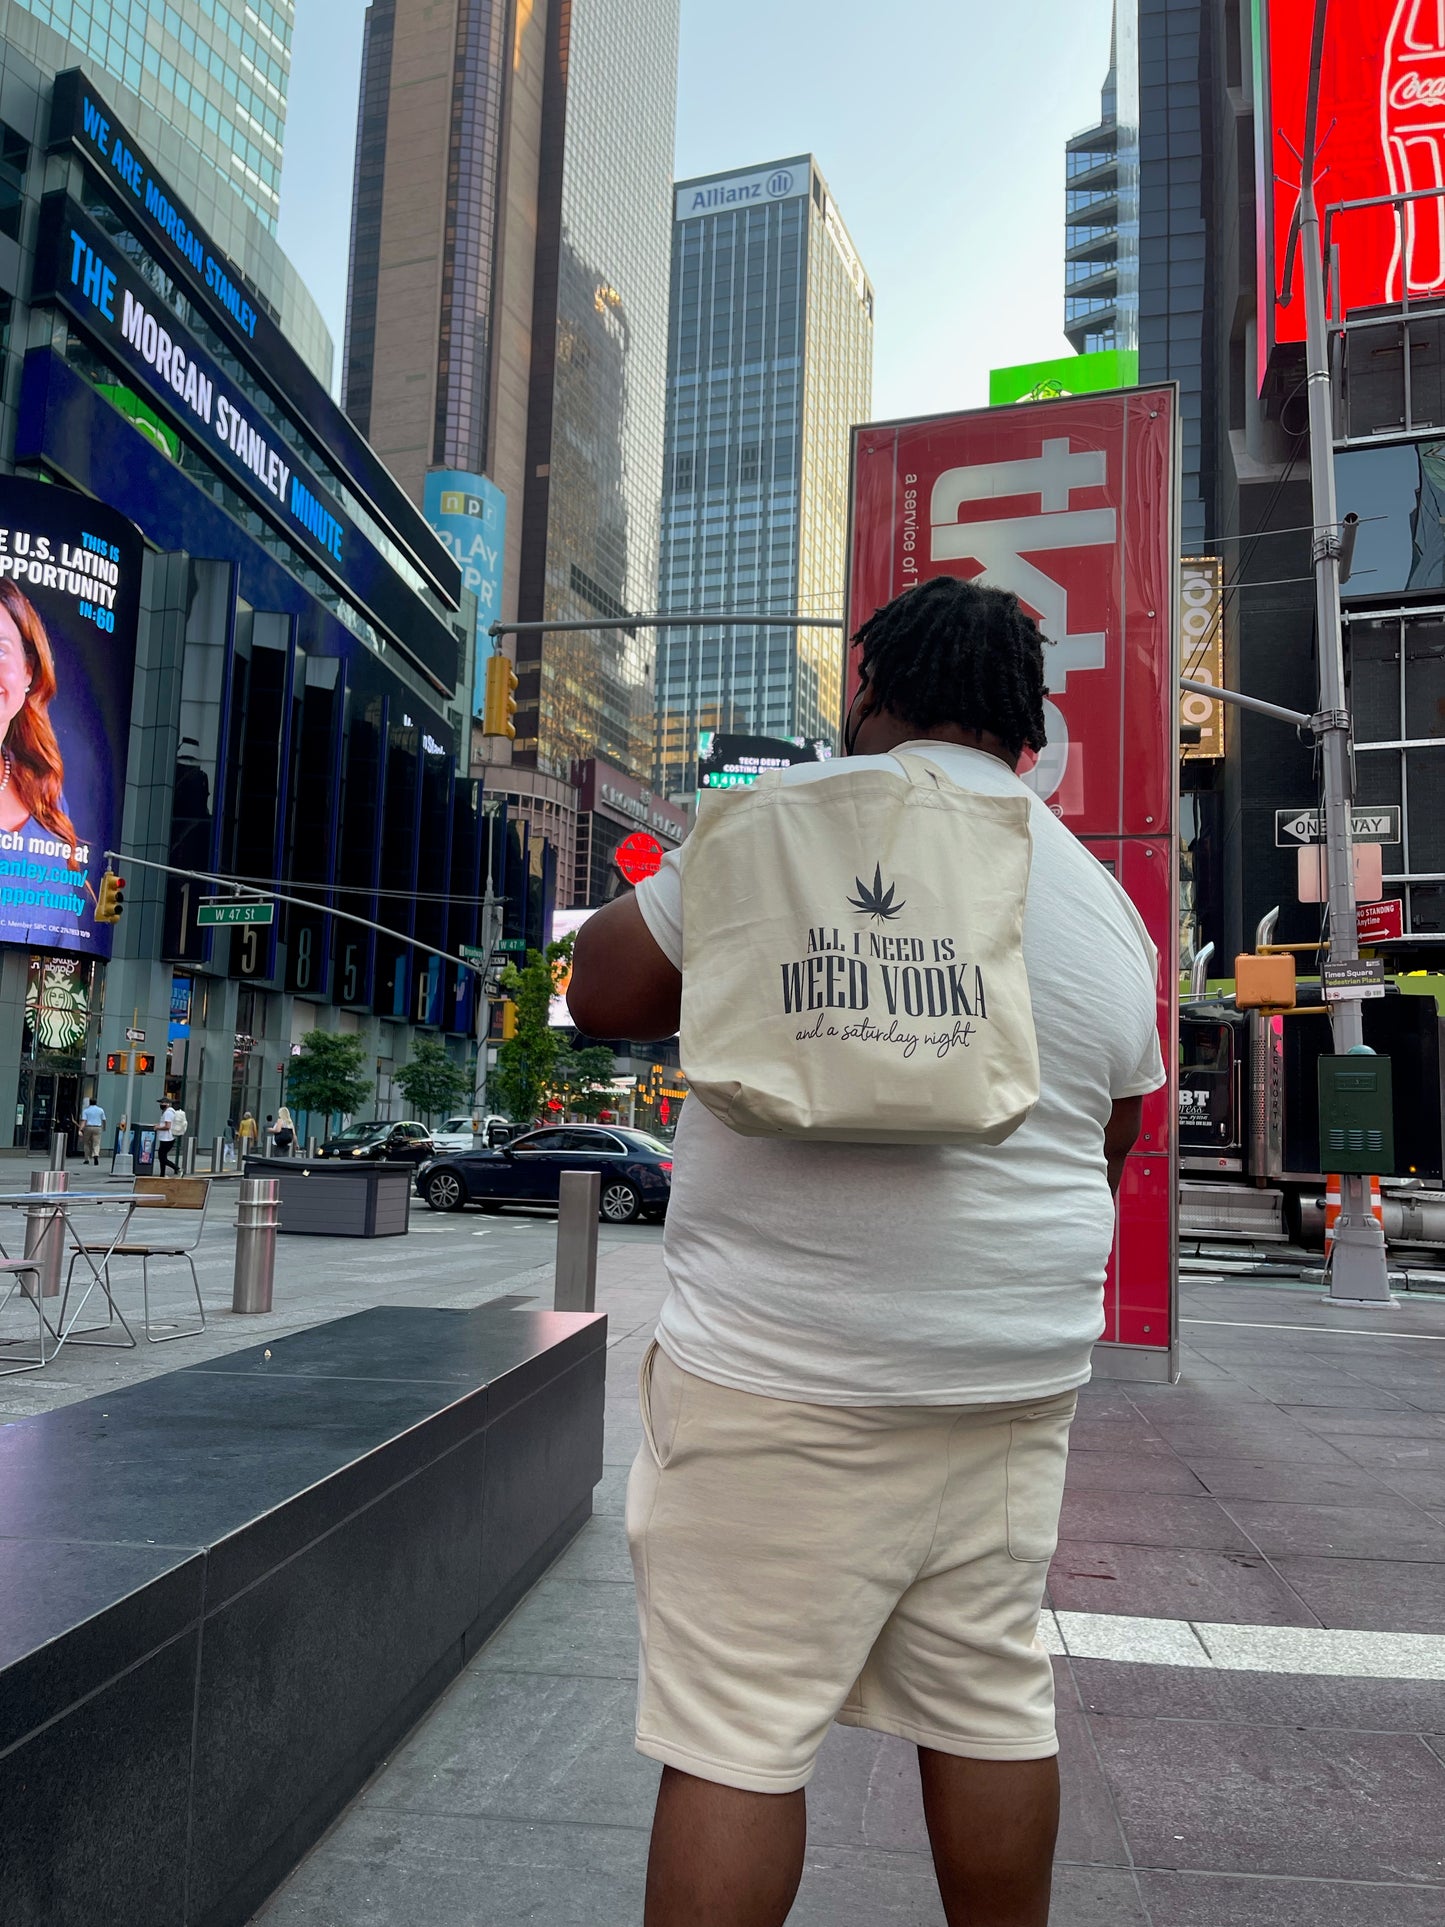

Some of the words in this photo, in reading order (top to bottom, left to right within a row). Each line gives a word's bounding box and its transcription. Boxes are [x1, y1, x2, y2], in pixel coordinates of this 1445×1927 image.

[1390, 71, 1445, 110] Coca
[691, 182, 761, 211] Allianz
[84, 97, 110, 156] WE
[111, 139, 143, 198] ARE
[145, 178, 203, 273] MORGAN
[205, 256, 257, 339] STANLEY
[70, 230, 117, 323] THE
[121, 289, 213, 424] MORGAN
[215, 395, 290, 502] STANLEY
[291, 476, 344, 562] MINUTE
[905, 473, 918, 485] a
[446, 496, 493, 518] npr
[903, 489, 919, 552] service
[14, 532, 55, 562] U.S.
[61, 543, 119, 586] LATINO
[82, 531, 107, 556] THIS
[109, 545, 120, 562] IS
[902, 556, 918, 573] of
[0, 555, 117, 610] PPORTUNITY
[1183, 570, 1213, 659] TOO!
[723, 764, 757, 774] COSTING
[739, 757, 759, 765] TECH
[760, 758, 781, 766] DEBT
[28, 837, 71, 860] more
[75, 844, 89, 864] at
[0, 858, 88, 888] anley.com/
[0, 886, 85, 917] pportunity
[215, 909, 224, 921] W
[229, 908, 240, 920] 47
[245, 908, 255, 920] St
[1366, 904, 1395, 917] STANDING
[8, 920, 33, 929] Member
[1357, 917, 1380, 927] Anytime
[500, 941, 507, 950] W
[509, 940, 517, 950] 47
[807, 927, 845, 953] ALL
[853, 932, 860, 955] I
[869, 932, 925, 962] NEED
[931, 937, 956, 962] IS
[780, 955, 869, 1014] WEED
[880, 963, 988, 1019] VODKA
[1324, 970, 1345, 979] Times
[1346, 969, 1373, 978] Square
[796, 1013, 823, 1041] and
[827, 1024, 838, 1036] a
[841, 1017, 919, 1058] saturday
[924, 1020, 976, 1058] night
[1179, 1090, 1210, 1106] BT
[1179, 1105, 1202, 1114] ress
